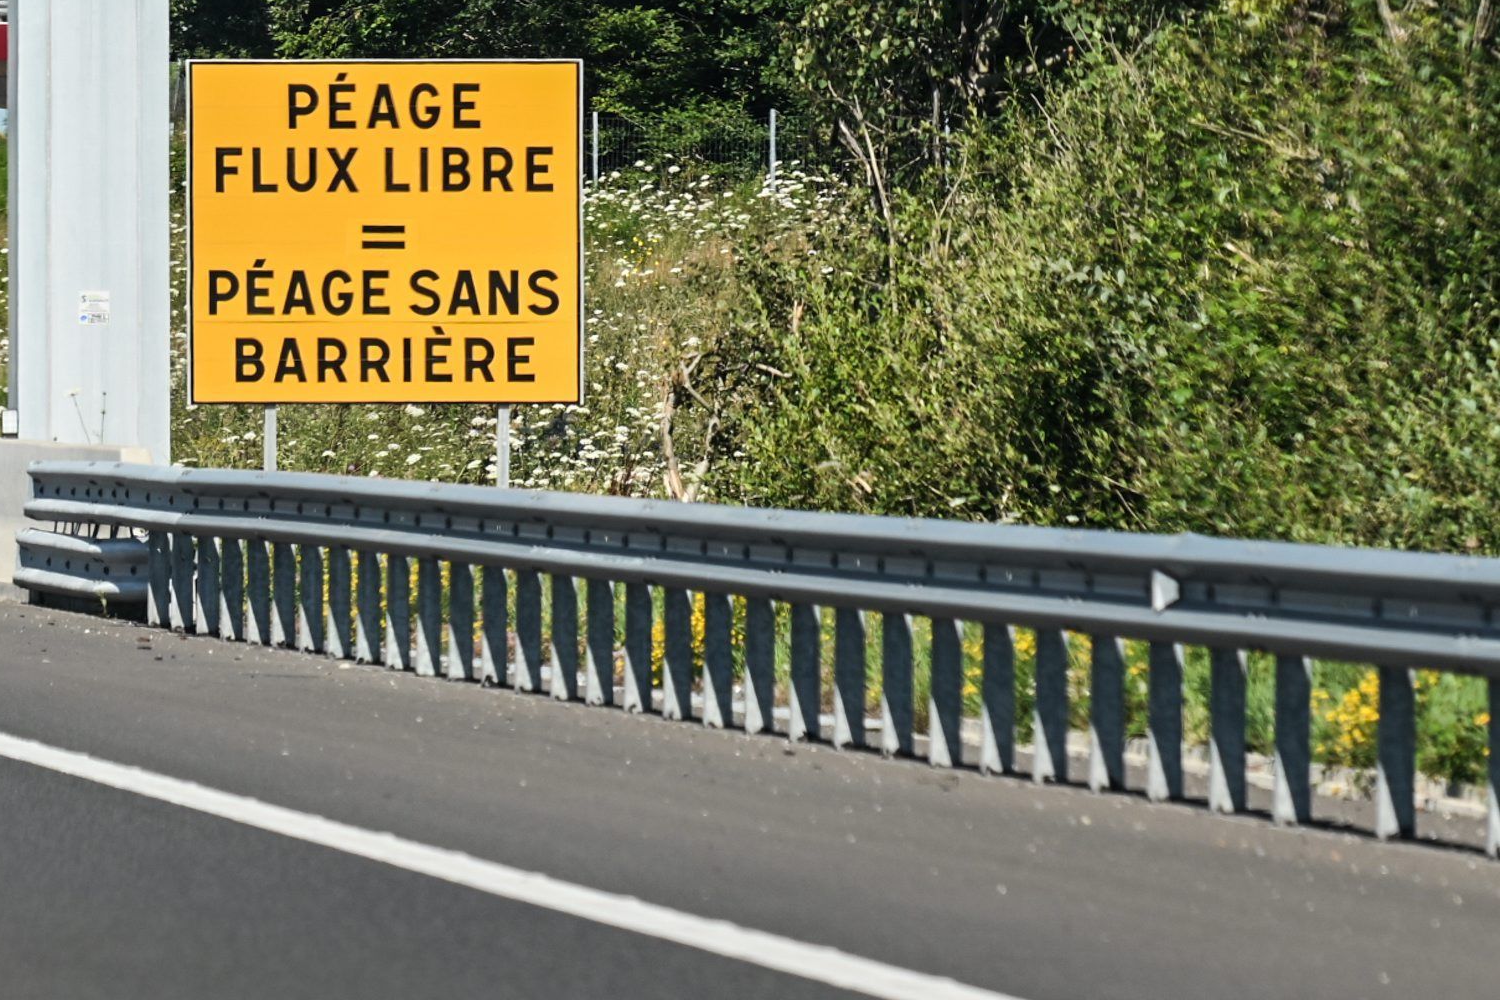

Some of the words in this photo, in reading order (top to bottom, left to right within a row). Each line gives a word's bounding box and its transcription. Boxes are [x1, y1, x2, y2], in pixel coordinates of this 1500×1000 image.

[288, 73, 481, 129] PÉAGE
[216, 147, 358, 192] FLUX
[385, 147, 553, 192] LIBRE
[362, 225, 405, 249] =
[209, 259, 390, 315] PÉAGE
[410, 270, 559, 315] SANS
[236, 326, 535, 382] BARRIÈRE
